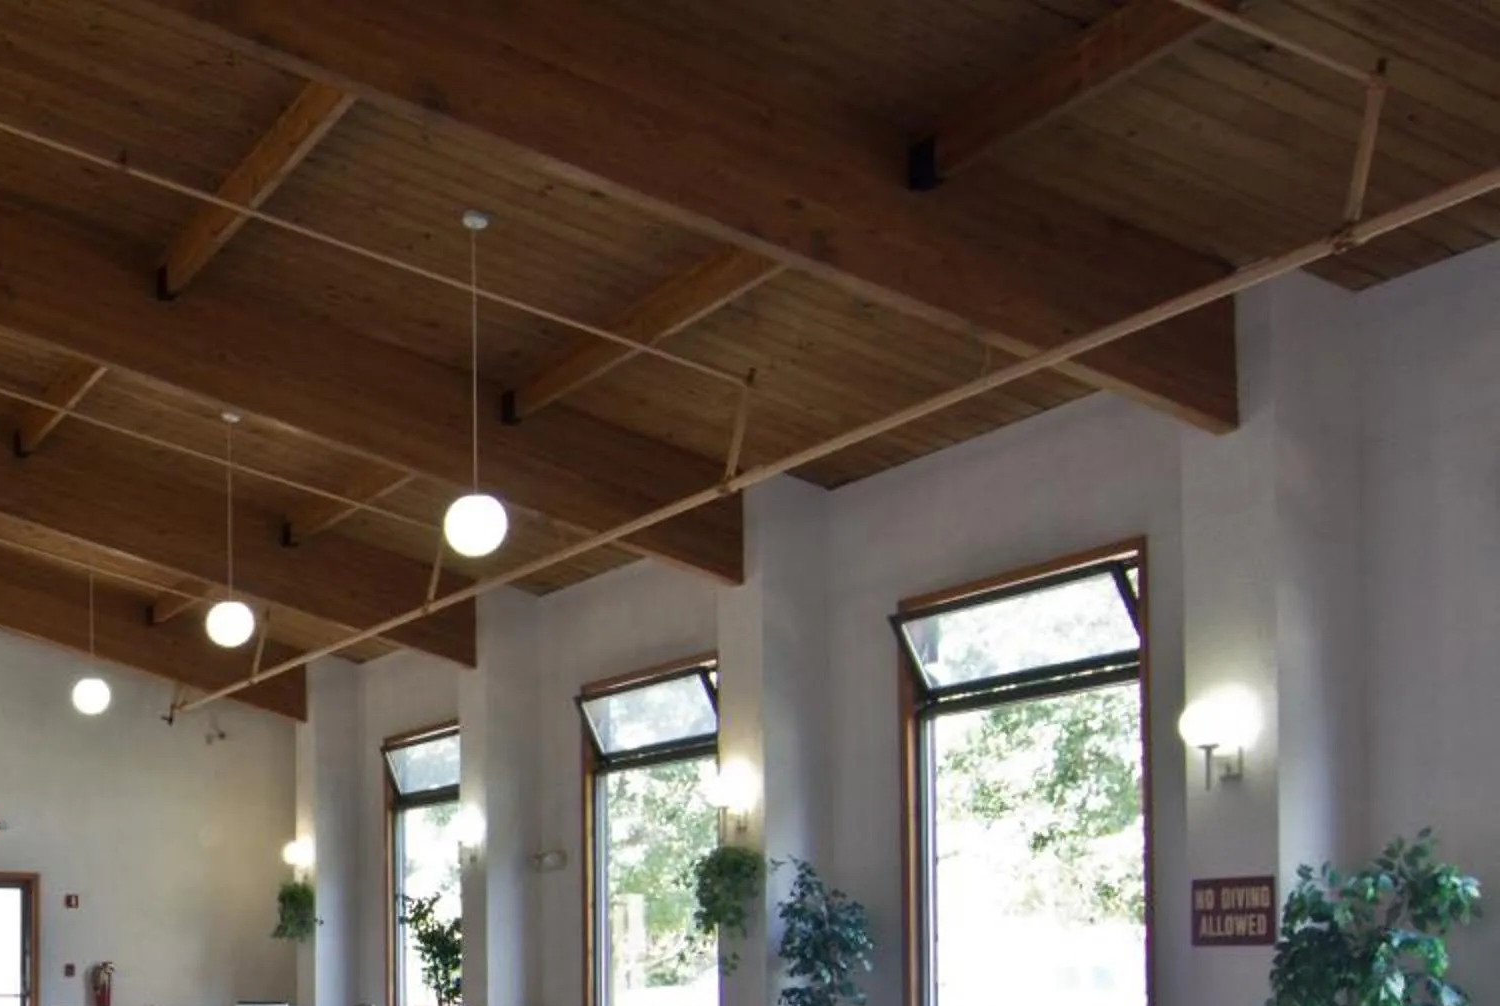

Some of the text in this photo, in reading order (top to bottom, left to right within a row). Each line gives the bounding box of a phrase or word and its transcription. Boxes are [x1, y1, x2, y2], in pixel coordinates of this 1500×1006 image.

[1195, 886, 1271, 910] NO DIVING
[1199, 913, 1267, 936] ALLOWED
